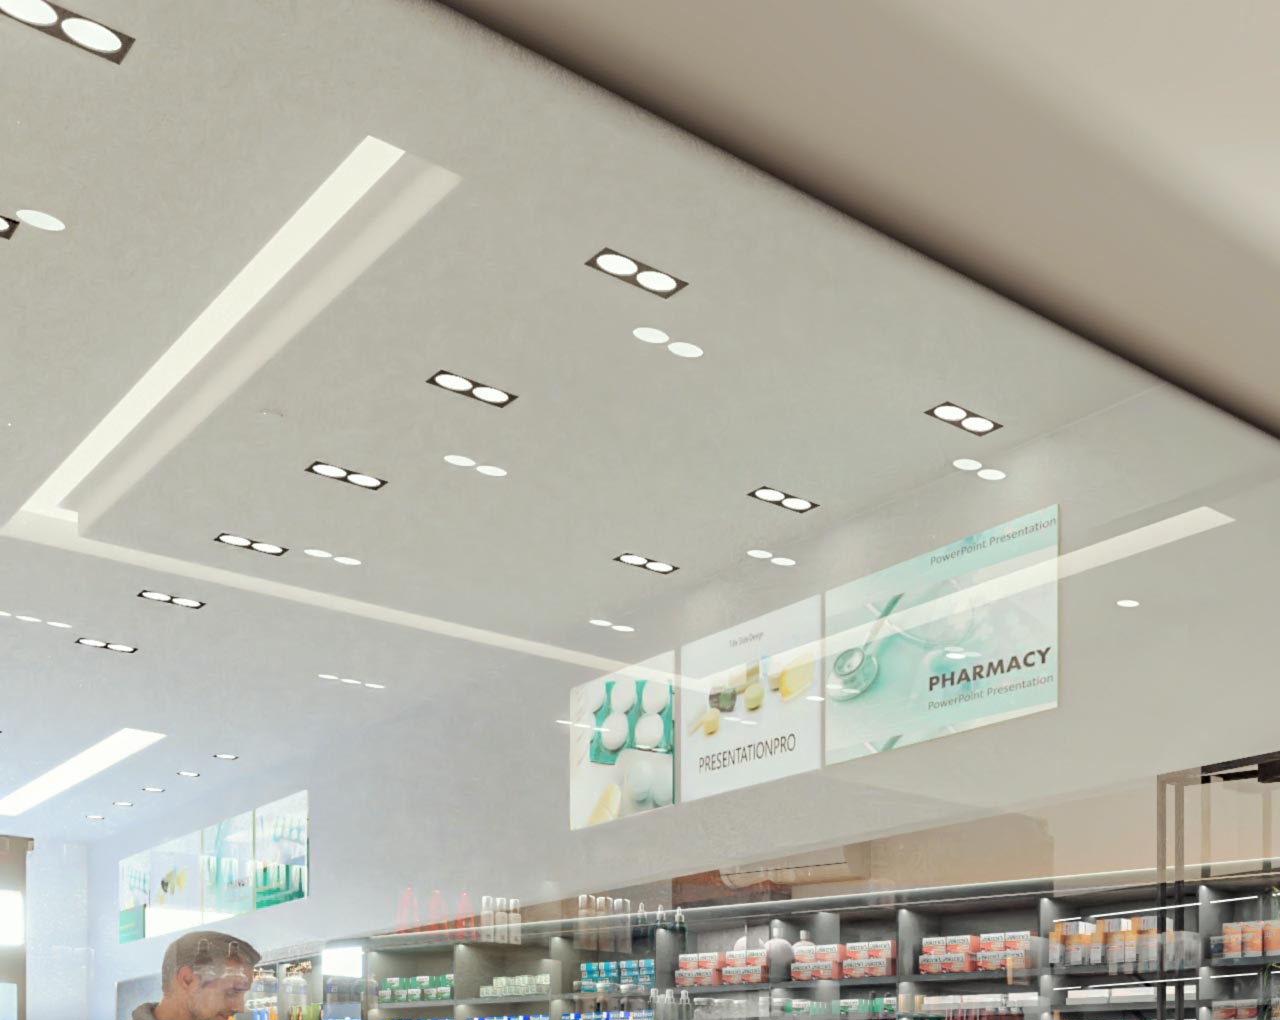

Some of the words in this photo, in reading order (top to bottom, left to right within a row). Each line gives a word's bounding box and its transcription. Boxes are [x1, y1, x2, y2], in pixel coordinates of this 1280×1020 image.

[930, 540, 986, 566] PowerPoint
[989, 518, 1057, 546] Presentation
[929, 647, 1052, 692] PHARMACY
[928, 689, 984, 711] PowerPoint
[987, 674, 1054, 697] Presentation
[699, 733, 796, 773] PRESENTATIONPRO
